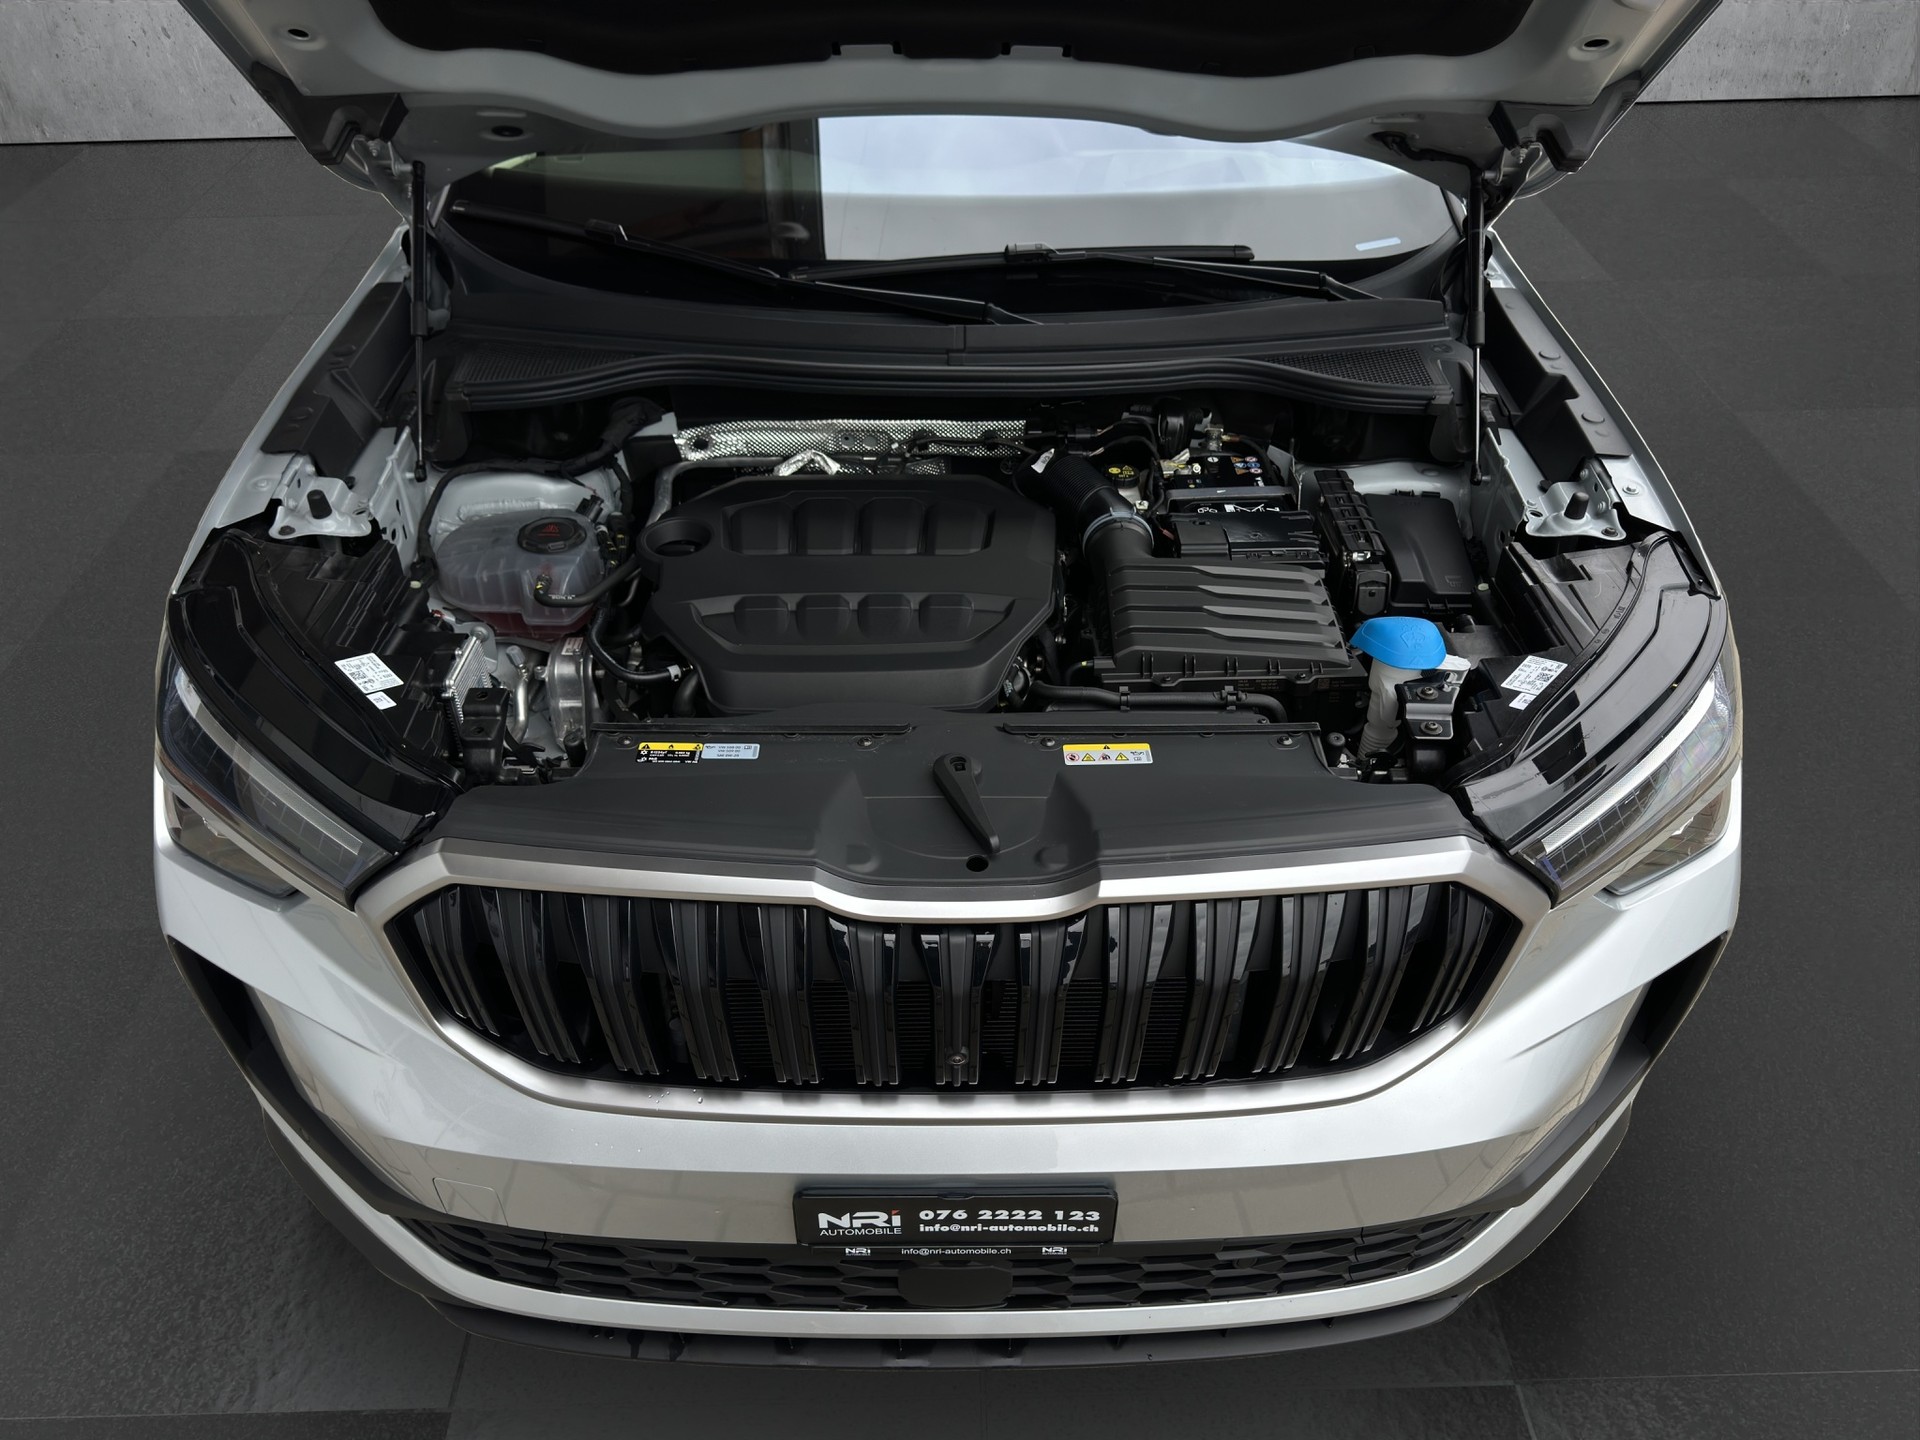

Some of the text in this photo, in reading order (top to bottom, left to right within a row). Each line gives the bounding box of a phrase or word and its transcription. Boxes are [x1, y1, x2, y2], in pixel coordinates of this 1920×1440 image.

[919, 1209, 1101, 1222] 076 2222 123
[819, 1228, 902, 1237] AUTOMOBILE
[919, 1223, 1099, 1233] info@nri-automobile.ch
[901, 1247, 1012, 1256] info@nri-automobile.ch
